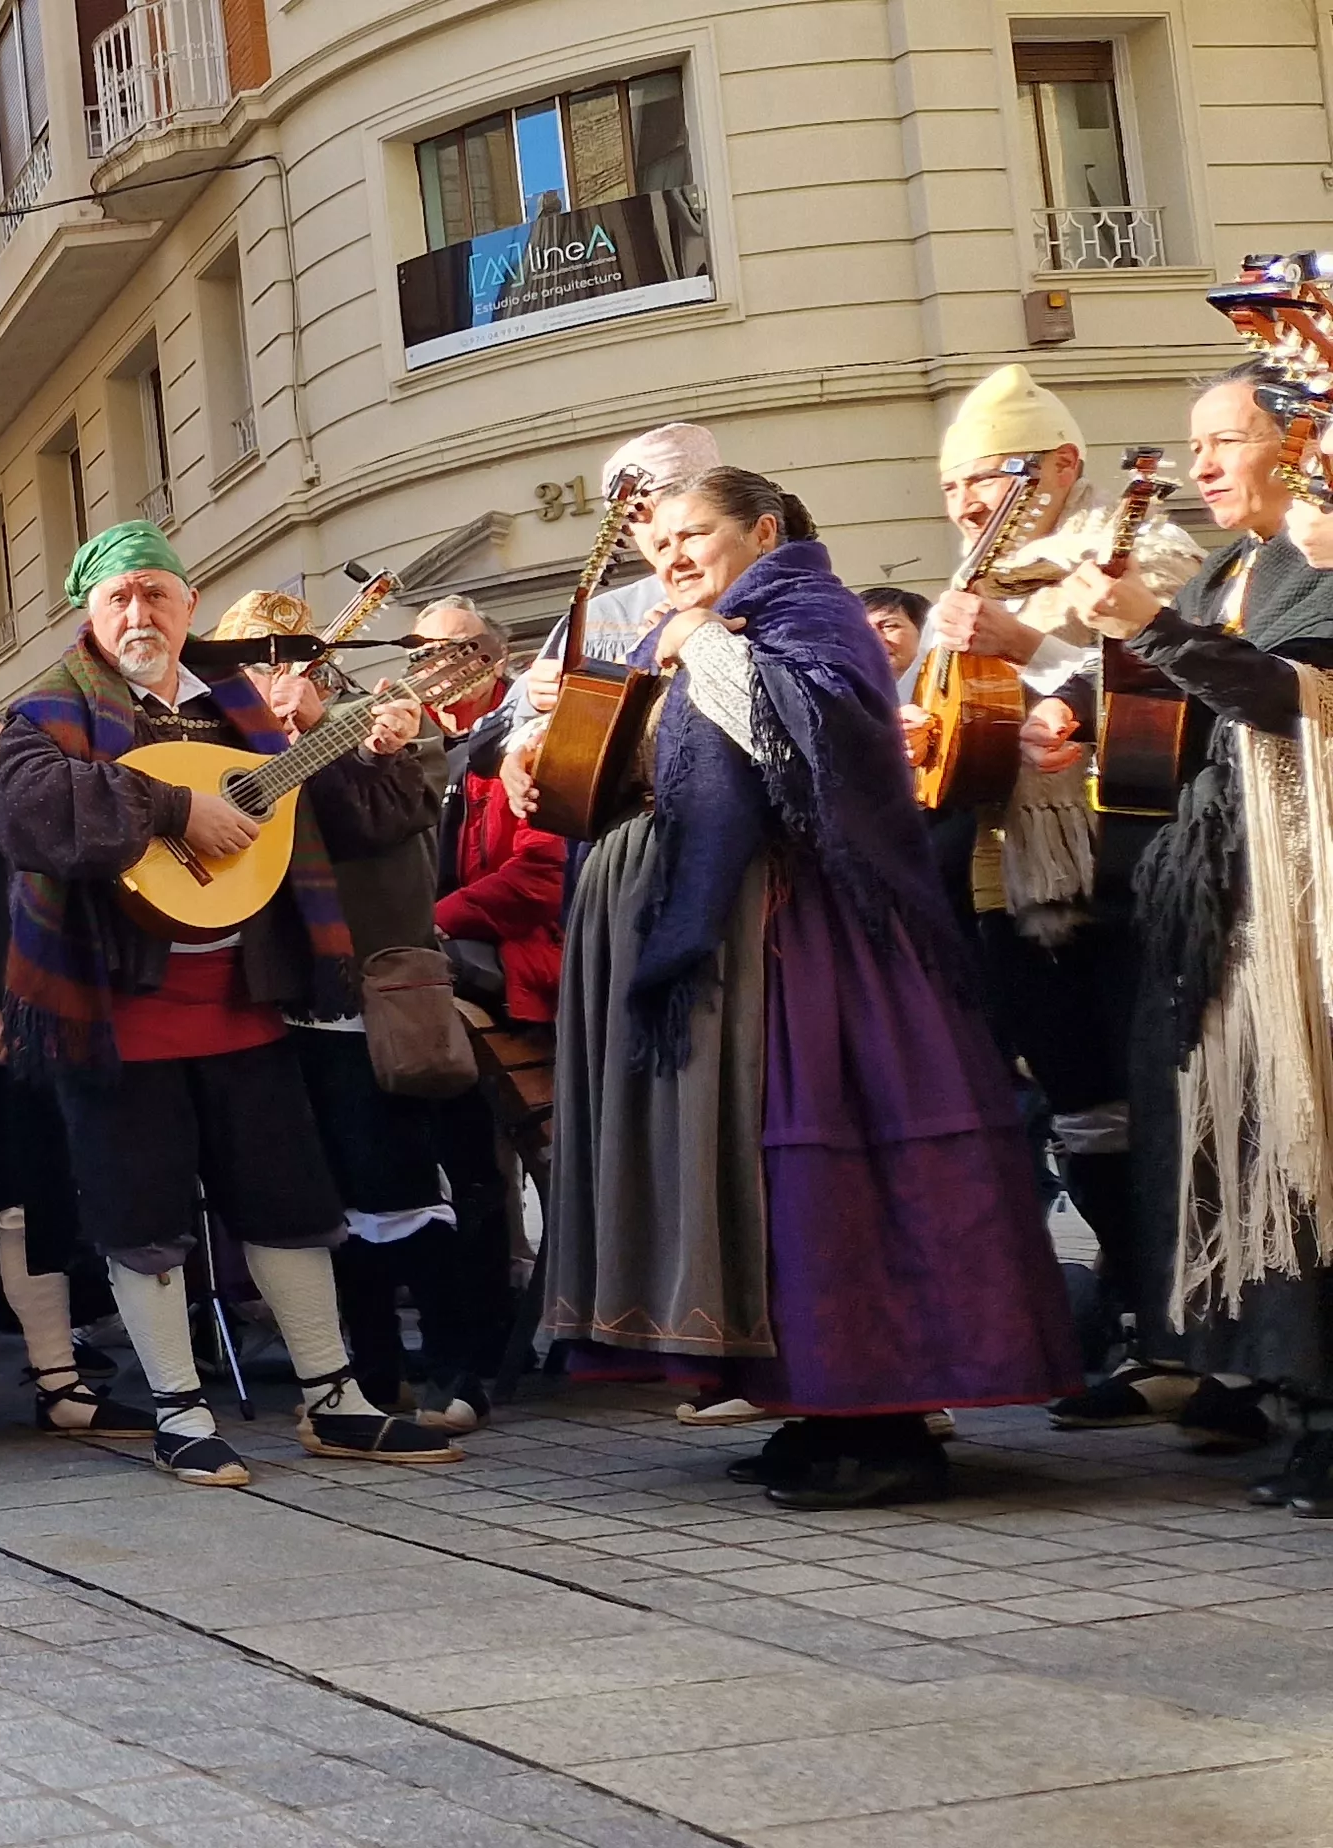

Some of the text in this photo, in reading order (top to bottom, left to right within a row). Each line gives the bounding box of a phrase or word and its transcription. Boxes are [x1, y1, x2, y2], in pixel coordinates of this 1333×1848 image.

[475, 271, 623, 315] Estudio de arquitectura
[534, 475, 594, 522] 31
